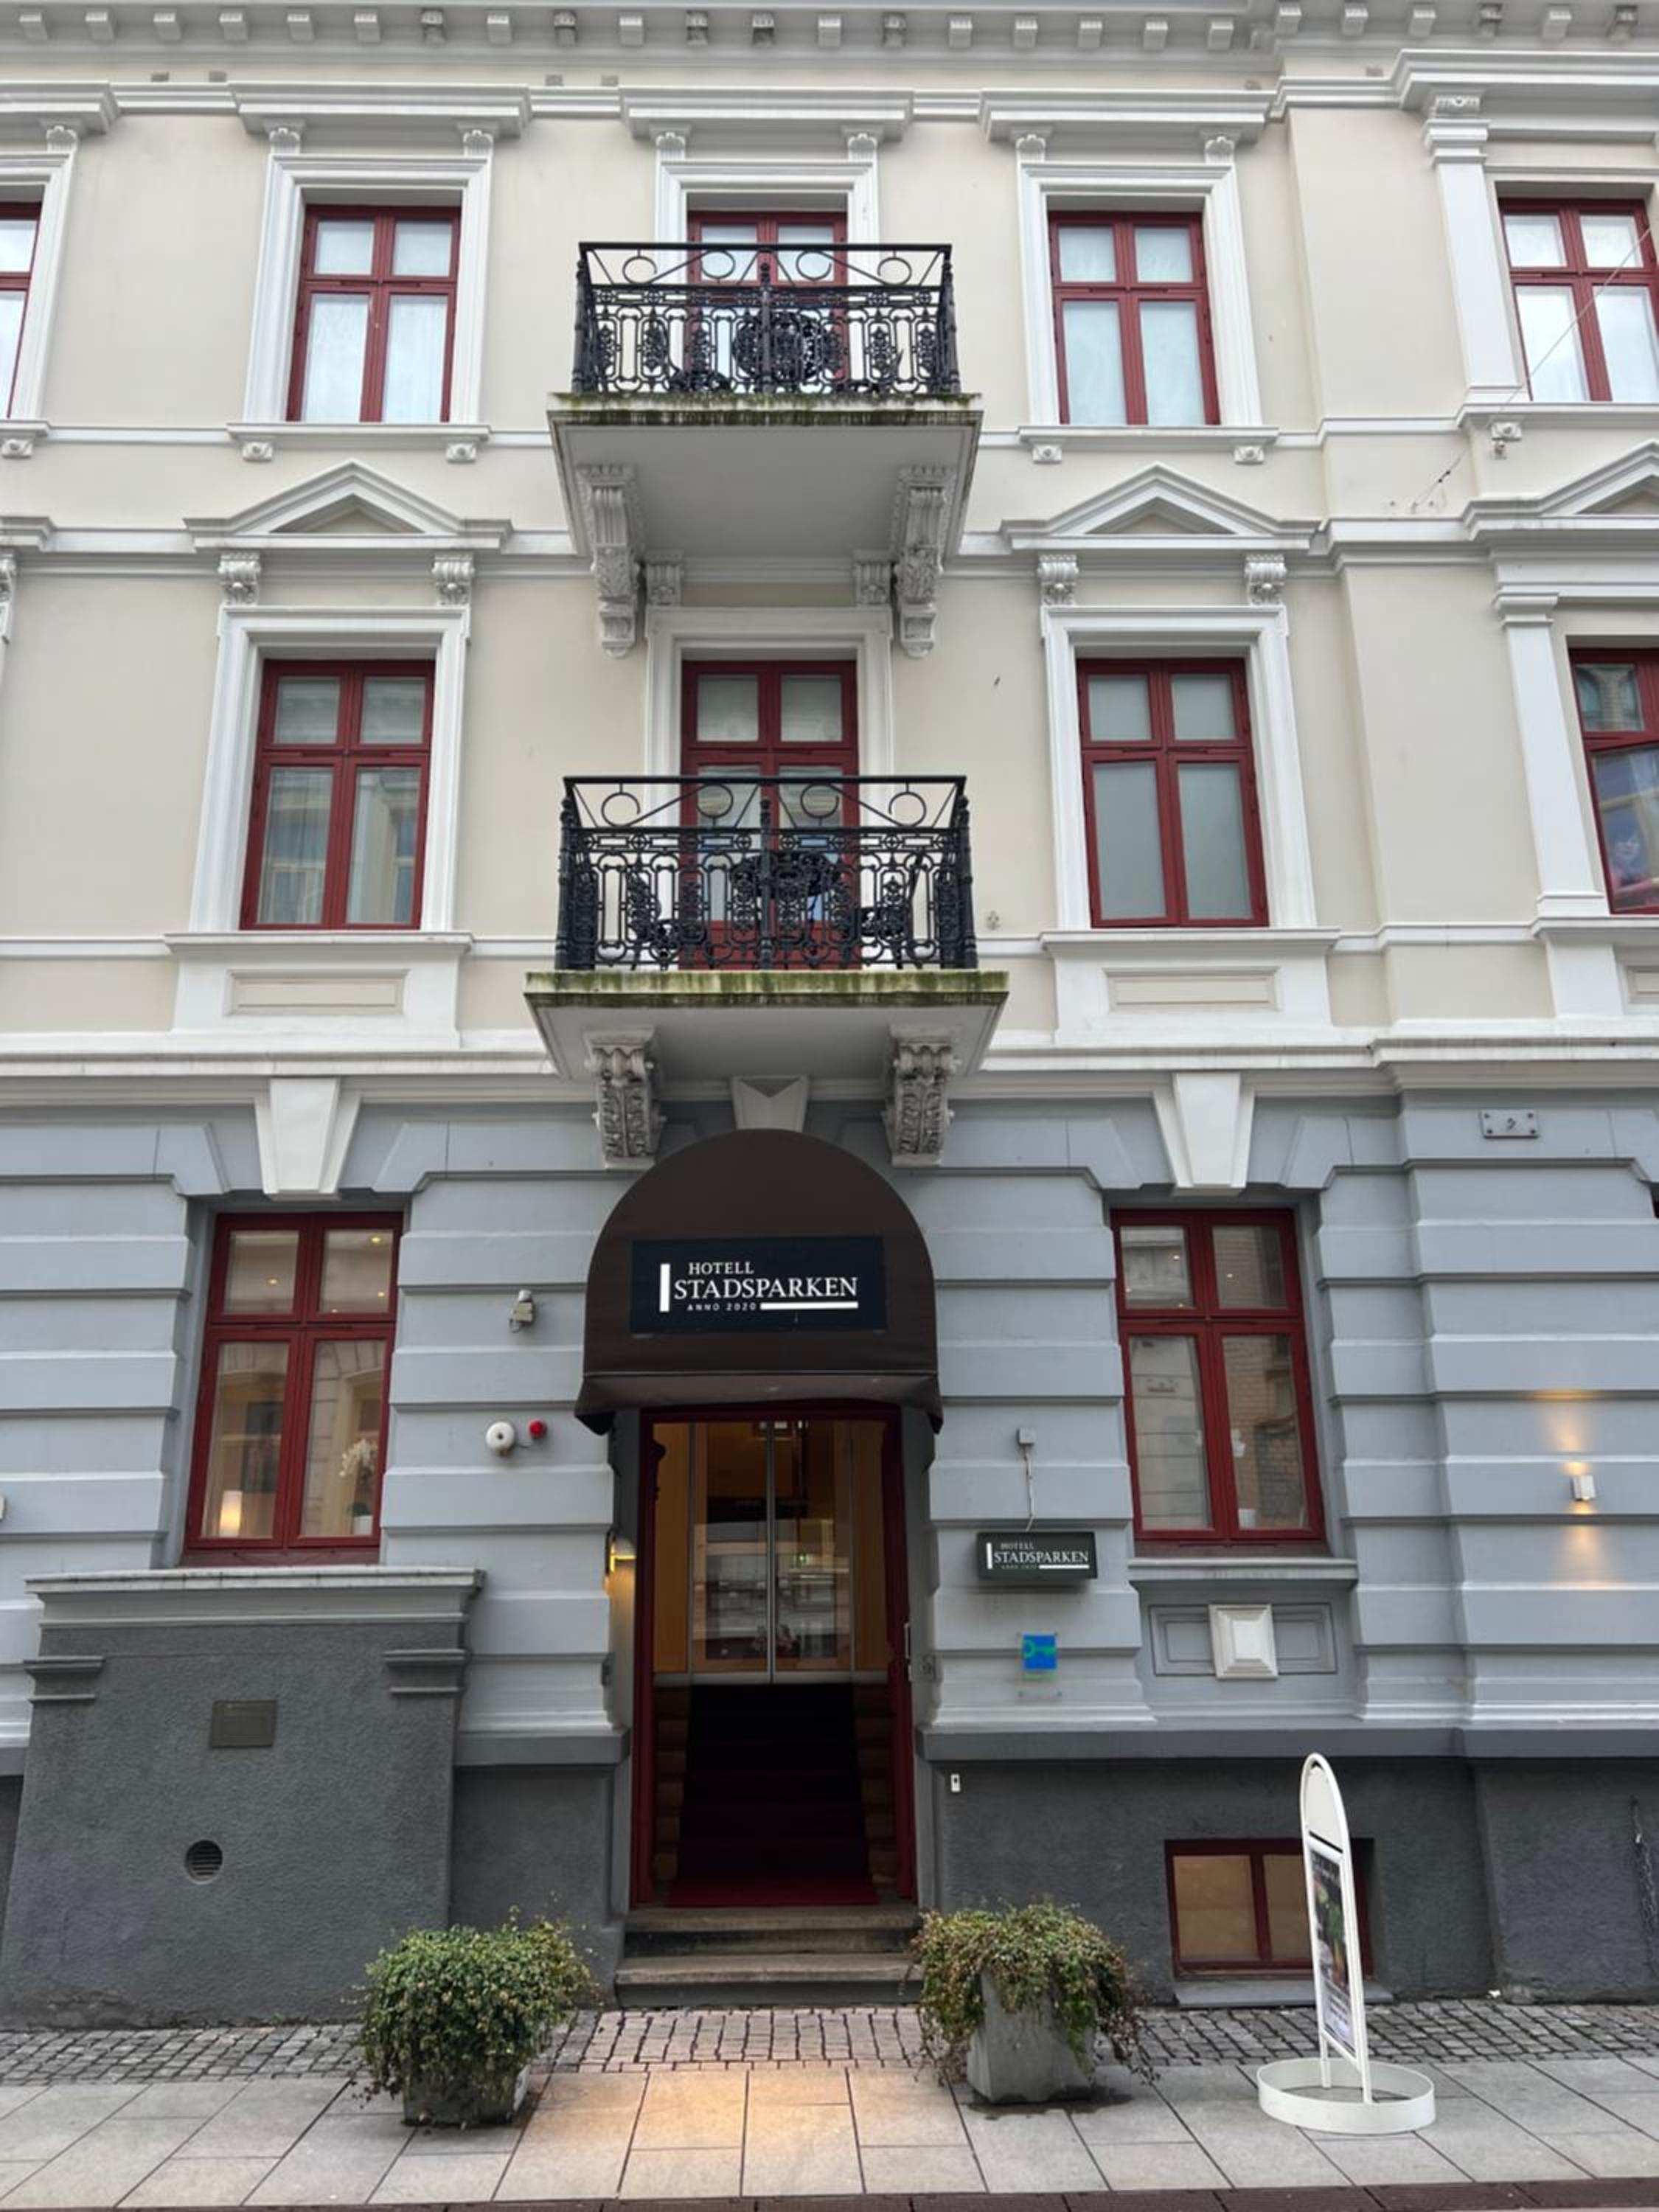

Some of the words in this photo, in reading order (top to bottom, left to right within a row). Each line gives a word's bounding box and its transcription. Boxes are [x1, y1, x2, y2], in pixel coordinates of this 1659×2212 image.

[688, 1262, 754, 1275] HOTELL
[674, 1277, 858, 1300] STADSPARKEN
[686, 1302, 720, 1312] ANNO
[726, 1301, 757, 1312] 2020
[994, 1551, 1089, 1563] STADSPARKEN
